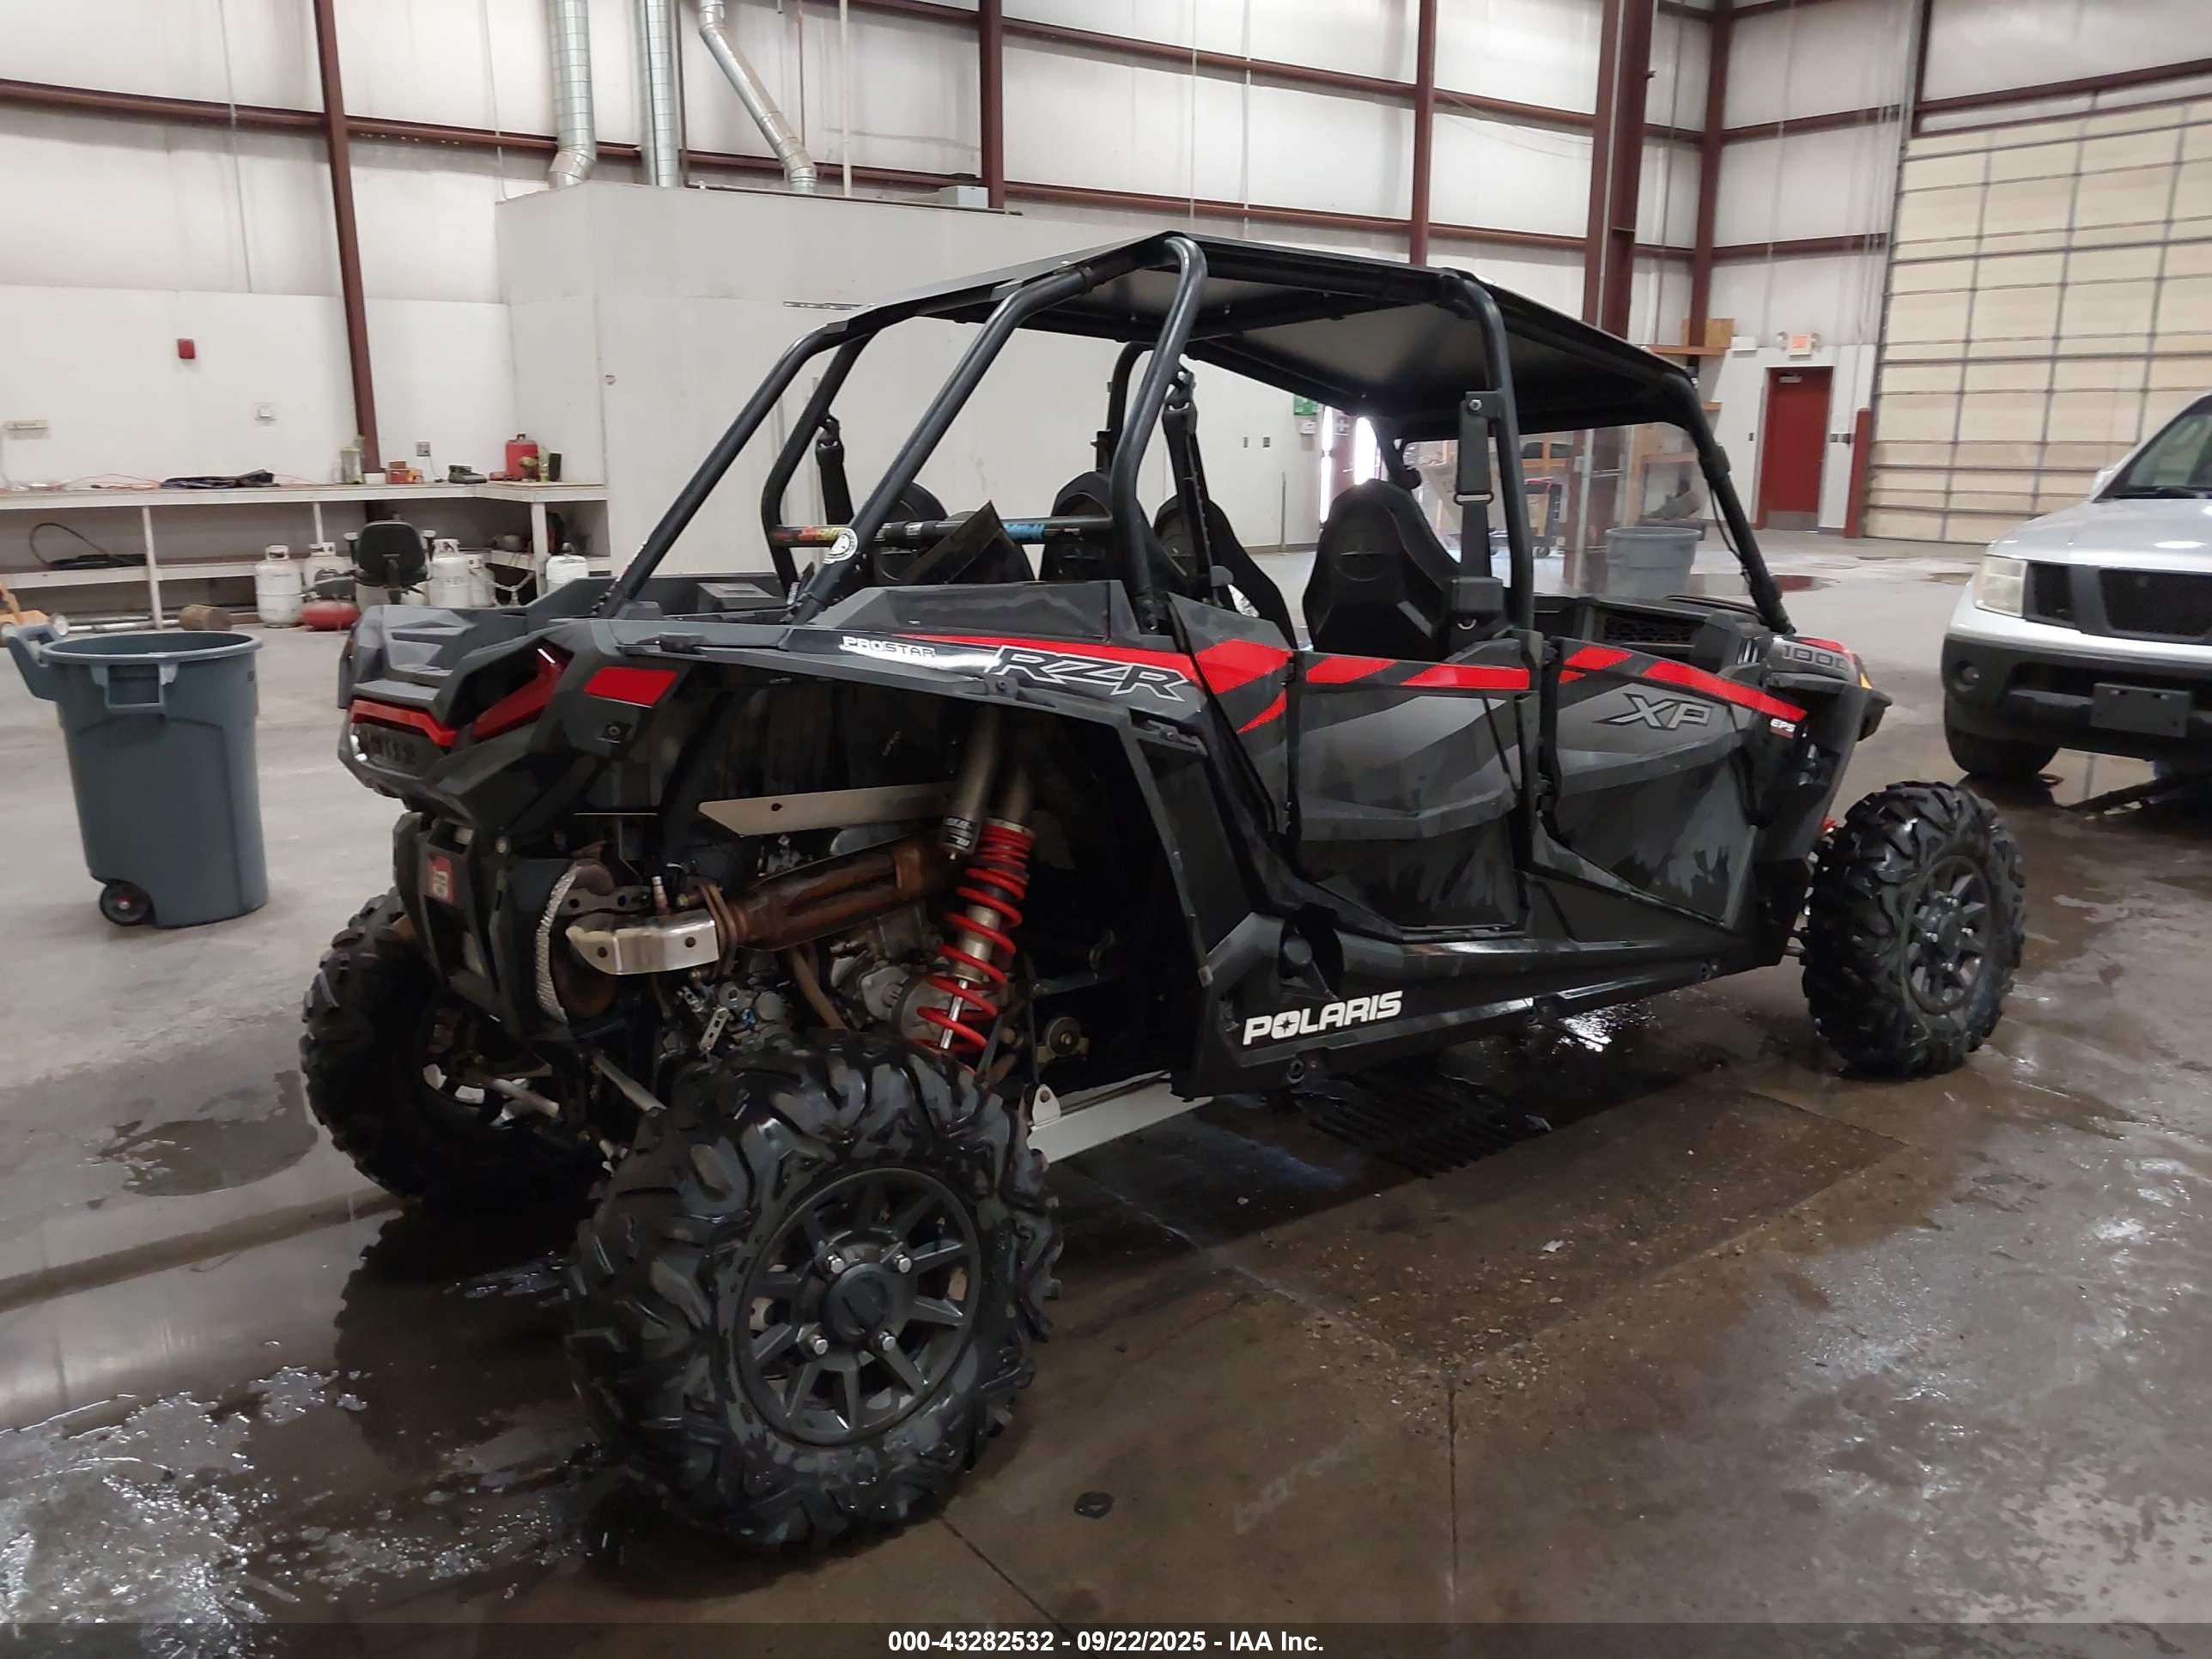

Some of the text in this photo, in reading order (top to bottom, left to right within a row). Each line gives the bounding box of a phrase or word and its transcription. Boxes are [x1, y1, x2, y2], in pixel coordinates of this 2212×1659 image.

[842, 635, 936, 658] PROSTAR
[986, 646, 1189, 702] RZR
[1595, 692, 1716, 732] XP
[1243, 990, 1403, 1045] POLARIS
